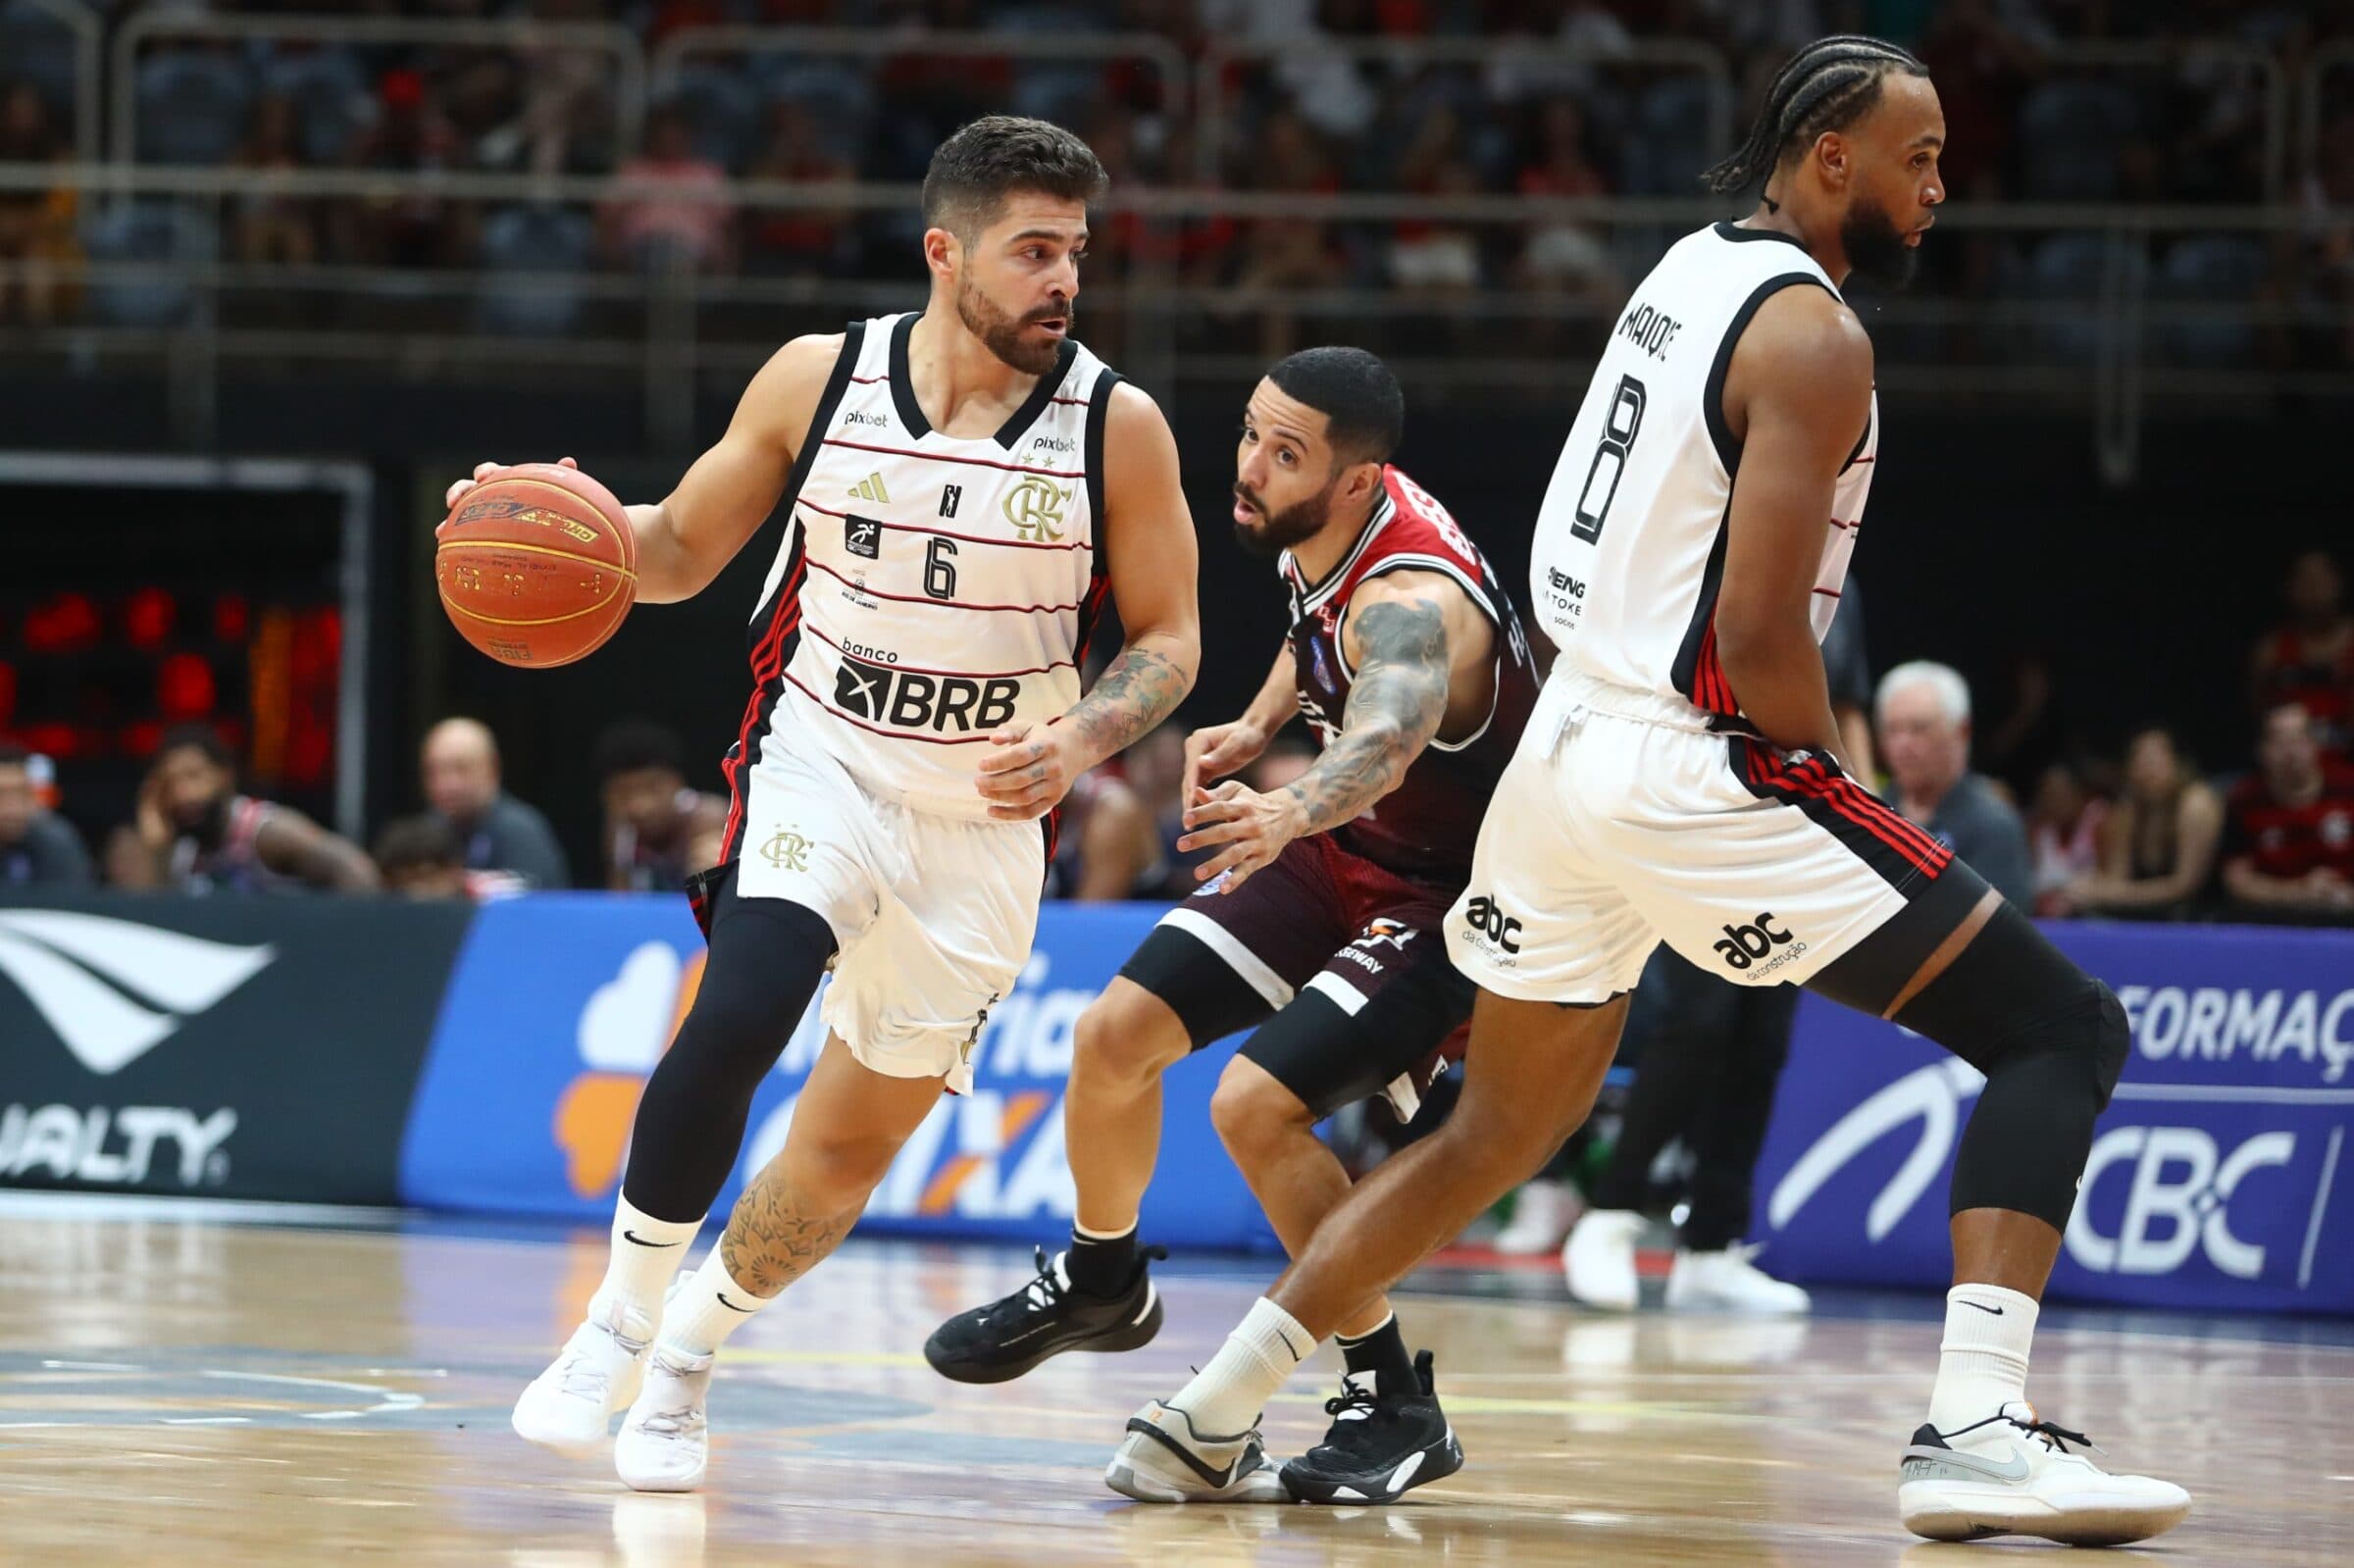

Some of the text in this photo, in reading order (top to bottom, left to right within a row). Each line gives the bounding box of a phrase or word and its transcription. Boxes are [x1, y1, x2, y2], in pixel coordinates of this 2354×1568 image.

[844, 410, 888, 428] pixbet
[1033, 436, 1076, 452] pixbet
[1570, 373, 1647, 546] 8
[924, 536, 958, 600] 6
[842, 636, 898, 664] banco
[890, 673, 1021, 733] BRB
[1465, 892, 1523, 954] abc
[1713, 912, 1794, 970] abc
[1757, 941, 1807, 977] construção
[2064, 1125, 2297, 1278] CBC
